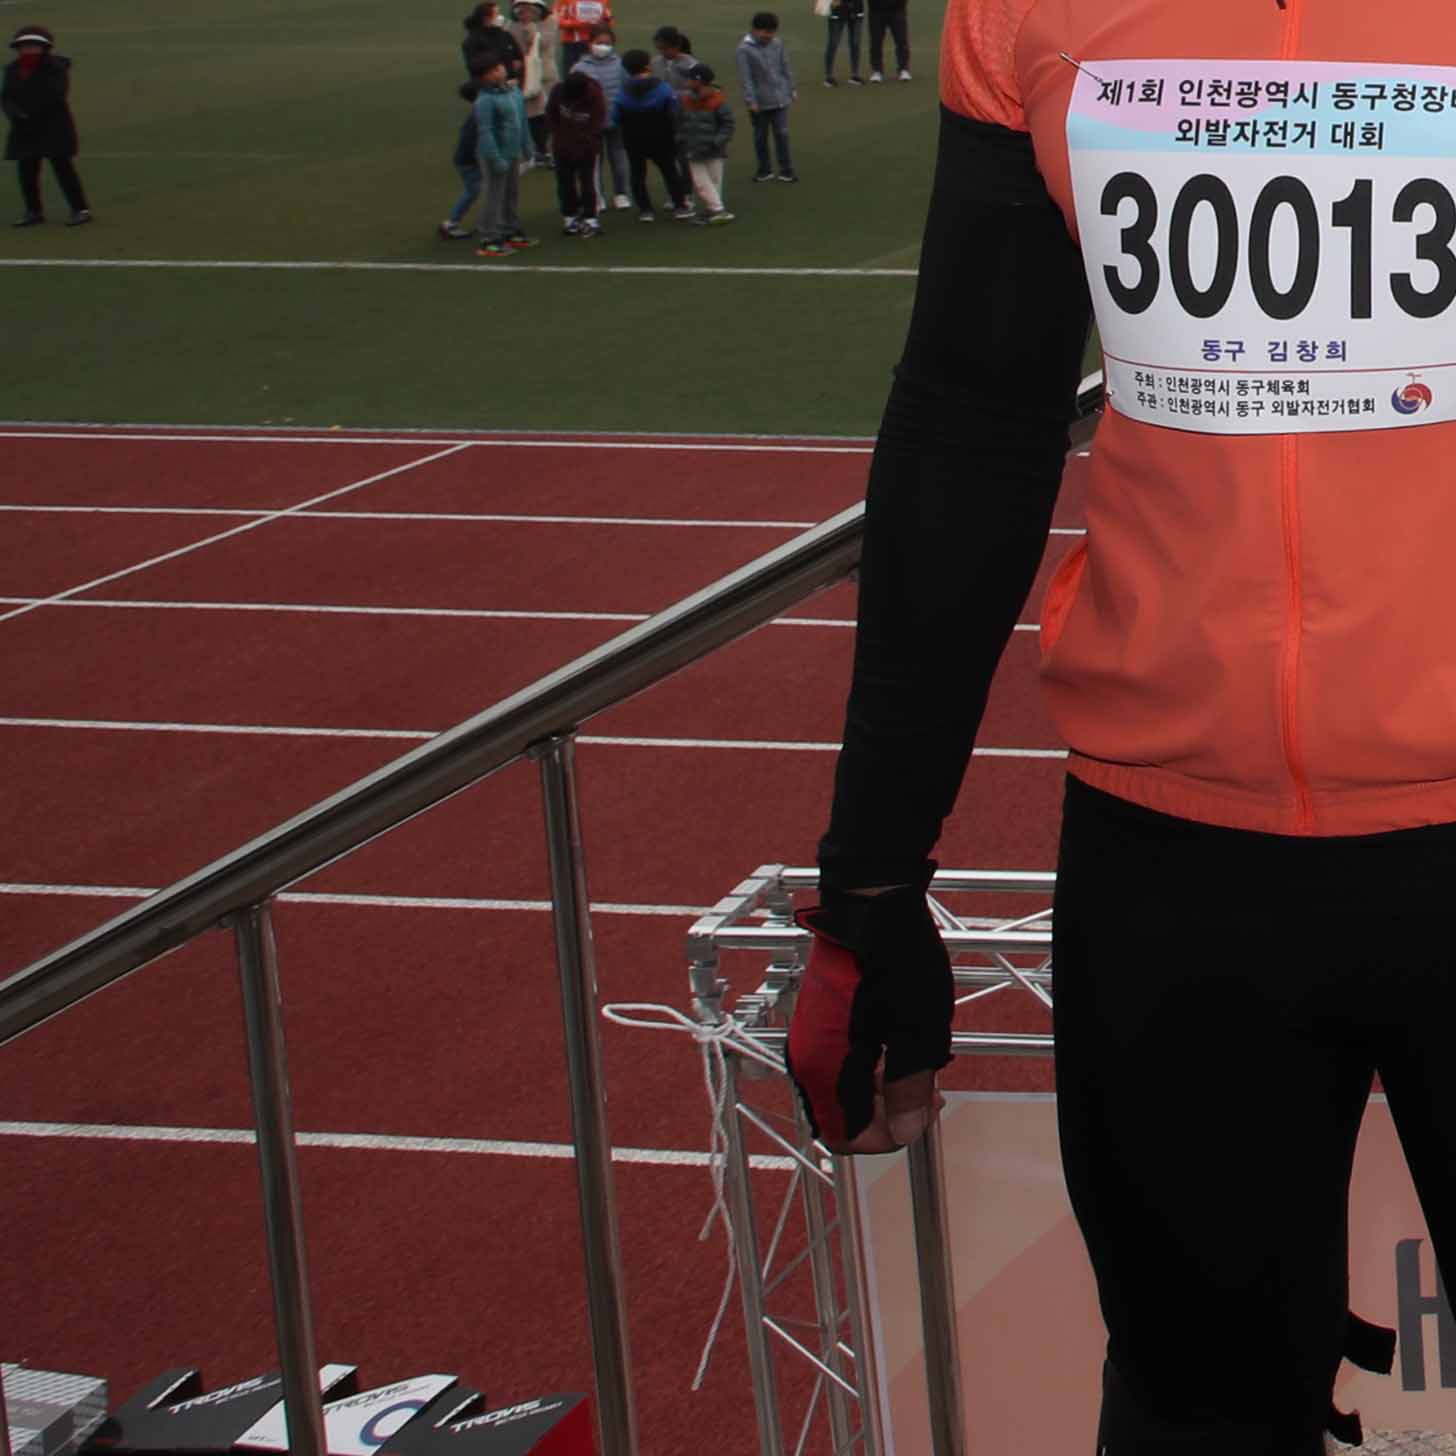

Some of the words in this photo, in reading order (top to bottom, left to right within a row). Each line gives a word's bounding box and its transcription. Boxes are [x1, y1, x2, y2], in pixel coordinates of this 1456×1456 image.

[1096, 79, 1165, 107] 제1회
[1178, 79, 1319, 110] 인천광역시
[1174, 118, 1318, 148] 외발자전거
[1331, 121, 1385, 150] 대회
[1201, 340, 1246, 363] 동구
[1166, 376, 1230, 397] 인천광역시
[1236, 378, 1310, 396] 동구체육회
[1167, 395, 1231, 416] 인천광역시
[1236, 399, 1265, 417] 동구
[1270, 397, 1376, 416] 외발자전거협회
[450, 1398, 542, 1434] TROVIS
